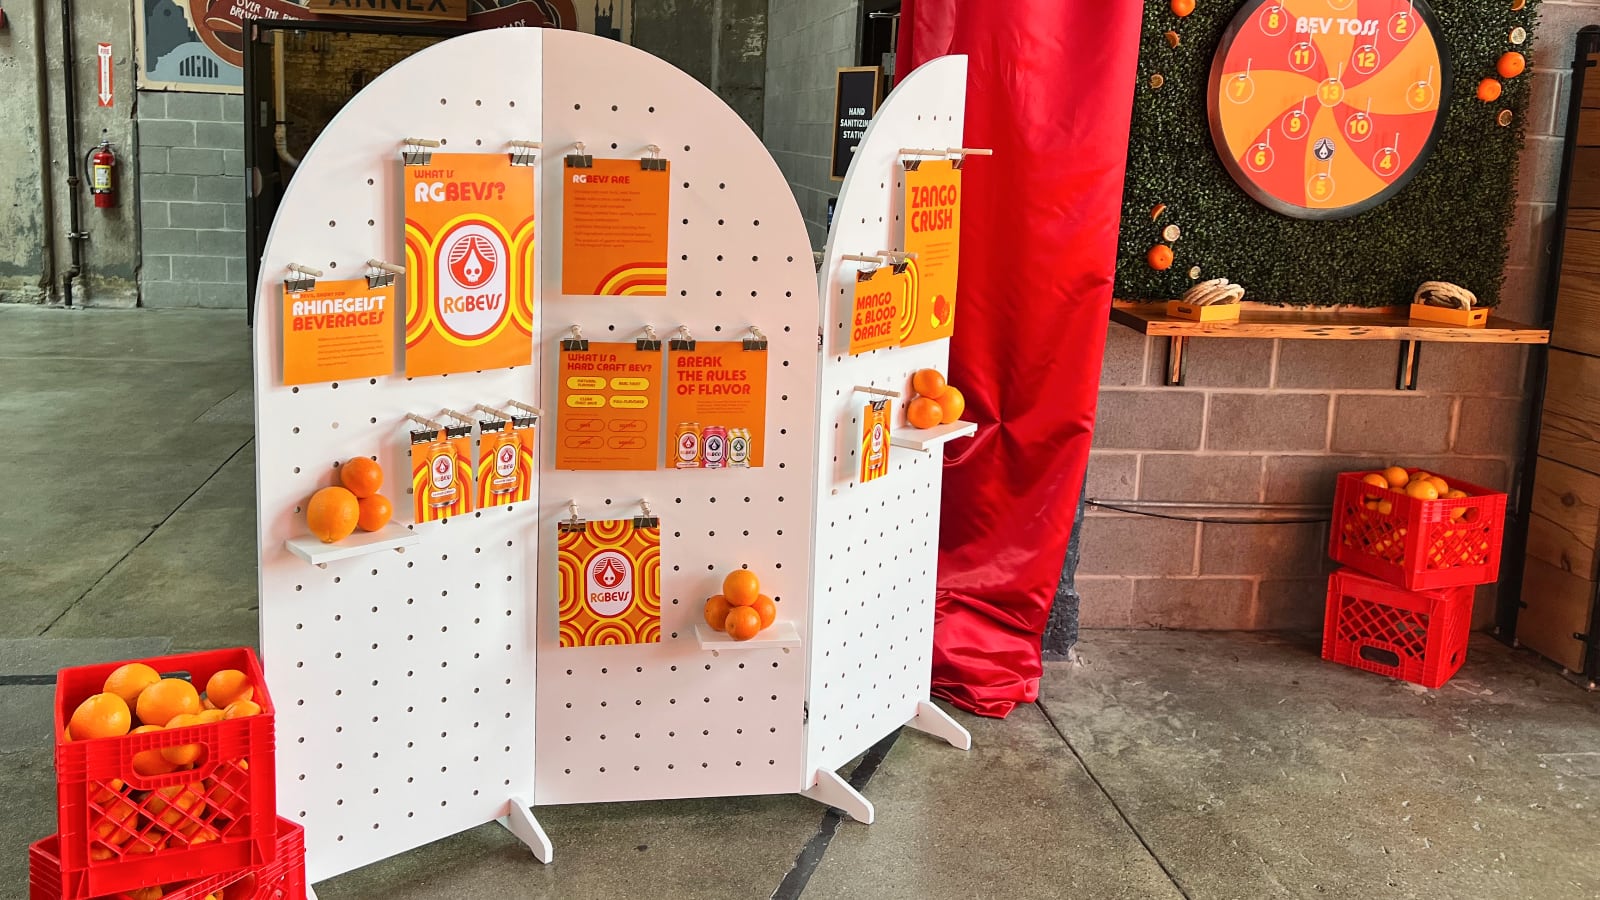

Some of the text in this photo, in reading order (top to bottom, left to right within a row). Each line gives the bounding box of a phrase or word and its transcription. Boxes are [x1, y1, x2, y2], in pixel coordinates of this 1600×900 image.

[1268, 14, 1279, 29] 8
[1295, 16, 1379, 36] BEV TOSS
[1396, 19, 1407, 34] 2
[1294, 50, 1310, 65] 11
[1358, 53, 1375, 67] 12
[1235, 82, 1246, 97] 7
[1321, 85, 1339, 99] 13
[1415, 88, 1425, 102] 3
[848, 107, 866, 116] HAND
[1290, 118, 1301, 132] 9
[1350, 120, 1368, 134] 10
[843, 130, 866, 139] STATIO
[1255, 151, 1266, 166] 6
[1380, 155, 1392, 169] 4
[414, 170, 455, 178] WHAT IS
[572, 174, 630, 184] RGBEVS ARE
[414, 181, 506, 202] RGBEVS?
[1316, 181, 1326, 195] 5
[911, 184, 957, 208] ZANGO
[911, 208, 953, 233] CRUSH
[292, 295, 386, 316] RHINEGEIST
[443, 293, 502, 314] RGBEVS
[856, 291, 892, 311] MANGO
[293, 311, 385, 331] BEVERAGES
[855, 306, 897, 326] & BLOOD
[854, 321, 892, 342] ORANGE
[567, 353, 617, 362] WHAT IS A
[677, 356, 722, 368] BREAK
[567, 362, 652, 372] HARD CRAFT BEV?
[677, 370, 747, 381] THE RULES
[677, 384, 751, 395] OF FLAVOR
[590, 591, 630, 602] RGBEVS
